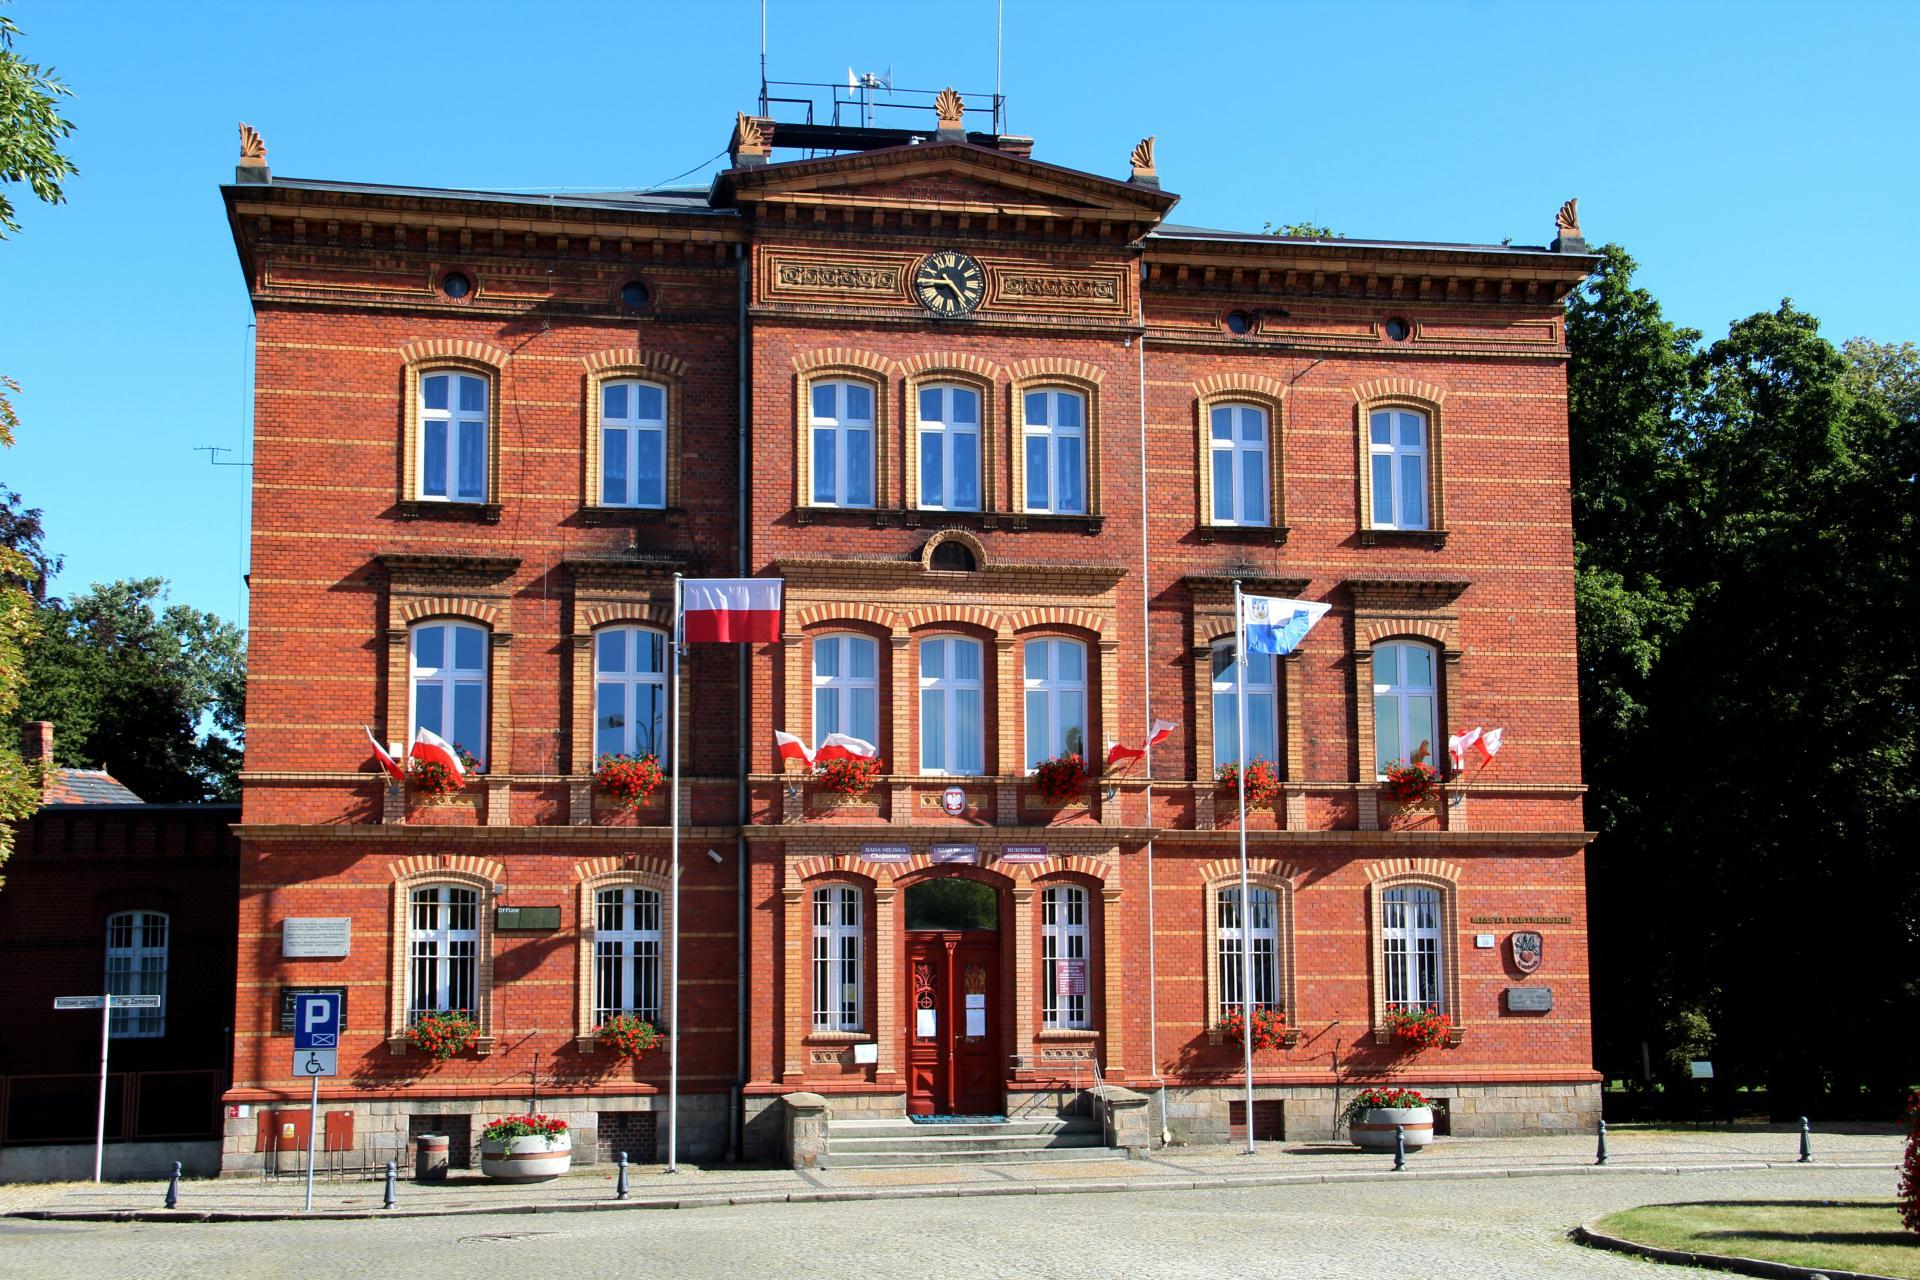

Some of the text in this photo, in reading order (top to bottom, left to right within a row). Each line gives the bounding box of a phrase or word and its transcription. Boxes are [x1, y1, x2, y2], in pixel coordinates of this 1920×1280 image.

[1471, 916, 1572, 924] MIASTA PARTNERSKIE
[305, 999, 331, 1033] P
